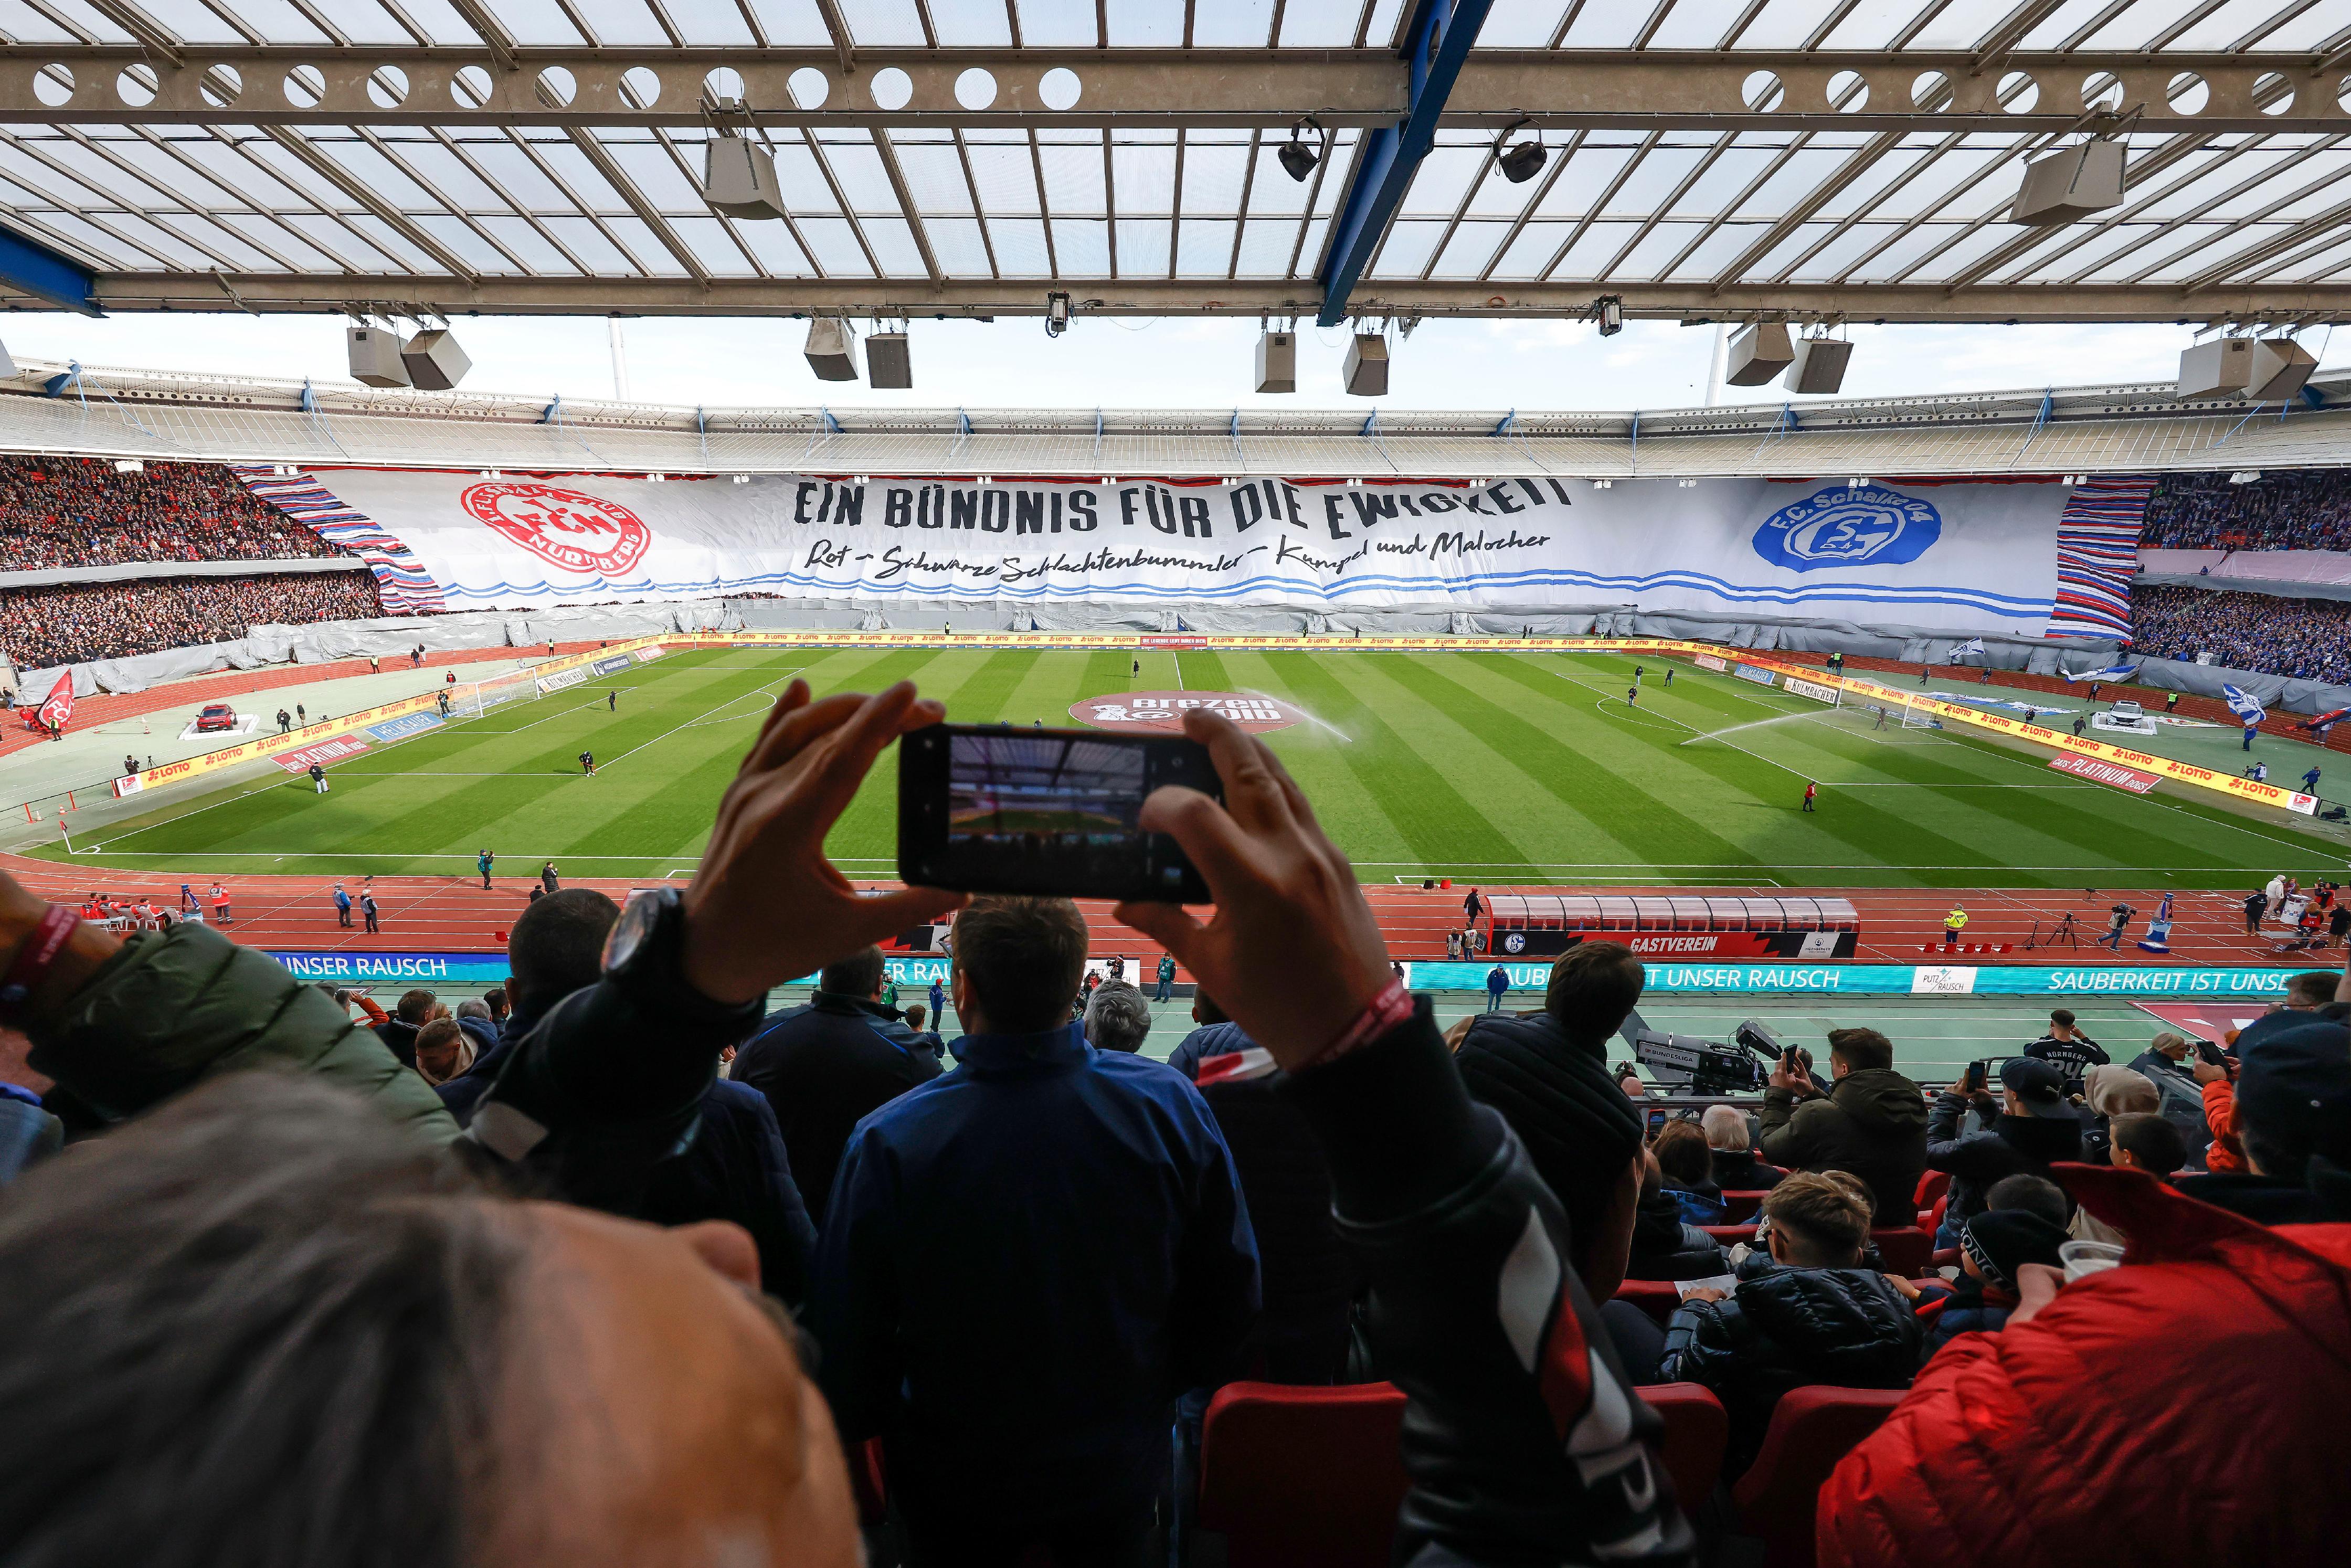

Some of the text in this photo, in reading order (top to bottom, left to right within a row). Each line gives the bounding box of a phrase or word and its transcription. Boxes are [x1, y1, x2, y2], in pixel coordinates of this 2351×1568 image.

[1813, 489, 1910, 508] Schalke
[794, 478, 1572, 540] EIN BÜNDNIS FÜR DIE EWIGKEIT
[528, 533, 640, 570] NÜRNBERG
[804, 539, 852, 568] Rot
[875, 546, 999, 579] Schwarze
[999, 547, 1244, 581] Schlachtenbummler
[1276, 534, 1368, 575] Kumpel
[1377, 534, 1427, 554] und
[1429, 530, 1551, 560] Malocher
[1739, 665, 1769, 681] HELMSAUER
[1784, 663, 1796, 672] LOTTO
[1807, 669, 1820, 678] LOTTO
[544, 670, 585, 690] KULMBACHER
[1859, 683, 1874, 692] LOTTO
[1792, 680, 1835, 704] KULMBACHER
[1888, 690, 1904, 700] LOTTO
[388, 702, 406, 714] LOTTO
[1919, 698, 1936, 708] LOTTO
[351, 712, 371, 724] LOTTO
[1952, 706, 1972, 717] LOTTO
[311, 722, 332, 735] LOTTO
[375, 713, 436, 738] HELMSAUER
[1988, 716, 2010, 727] LOTTO
[2029, 726, 2052, 739] LOTTO
[266, 735, 290, 750] LOTTO
[2074, 738, 2100, 751] LOTTO
[216, 748, 243, 762] LOTTO
[284, 740, 368, 771] CATS PLATINUM DOGS
[2124, 751, 2153, 765] LOTTO
[160, 762, 190, 778] LOTTO
[2052, 758, 2148, 791] CATS PLATINUM DOGS
[2180, 765, 2212, 781] LOTTO
[2243, 781, 2279, 798] LOTTO
[1630, 936, 1719, 952] GASTVEREIN
[357, 958, 448, 977] RAUSCH
[1666, 969, 1742, 988] UNSER
[1748, 969, 1840, 988] RAUSCH
[2048, 971, 2294, 990] SAUBERKEIT IST UNSE
[1938, 983, 1964, 991] RAUSCH
[1651, 1049, 1693, 1063] BUNDESLIGA
